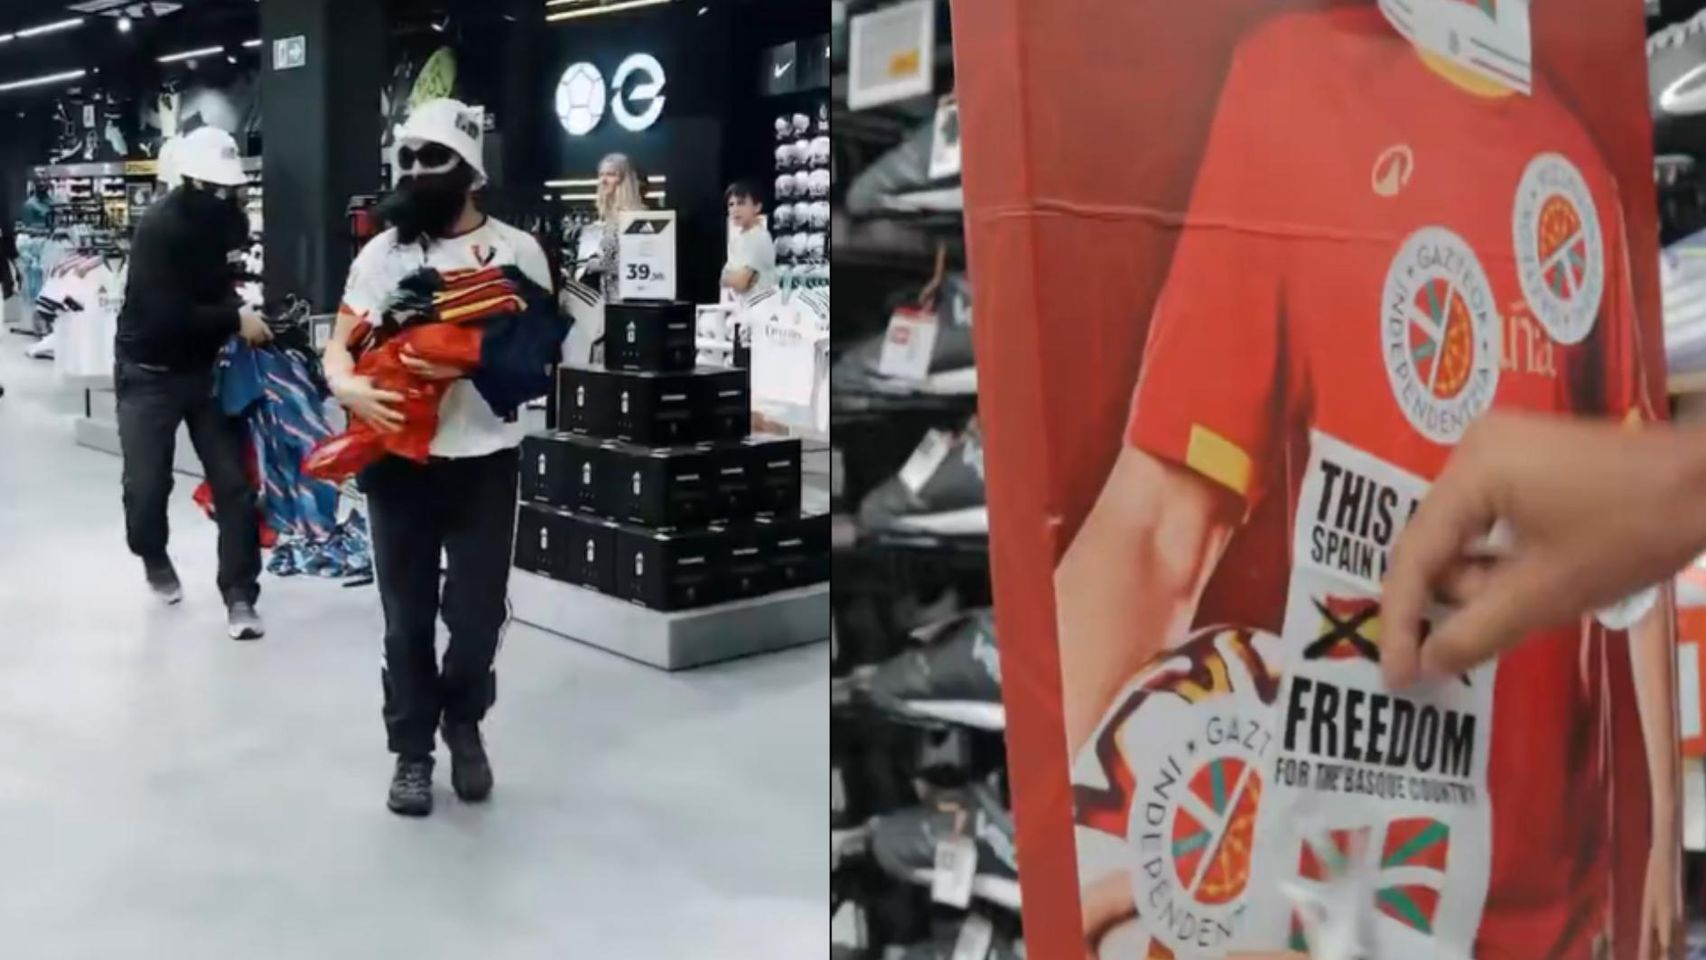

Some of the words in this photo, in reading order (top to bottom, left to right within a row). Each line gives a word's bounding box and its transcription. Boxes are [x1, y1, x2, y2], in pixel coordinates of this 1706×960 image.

[1318, 459, 1398, 546] THIS
[1311, 525, 1373, 579] SPAIN
[1207, 716, 1271, 757] GAZT
[1284, 676, 1476, 778] FREEDOM
[1275, 757, 1311, 787] FOR
[1316, 763, 1342, 791] THE
[1343, 764, 1406, 799] BASQUE
